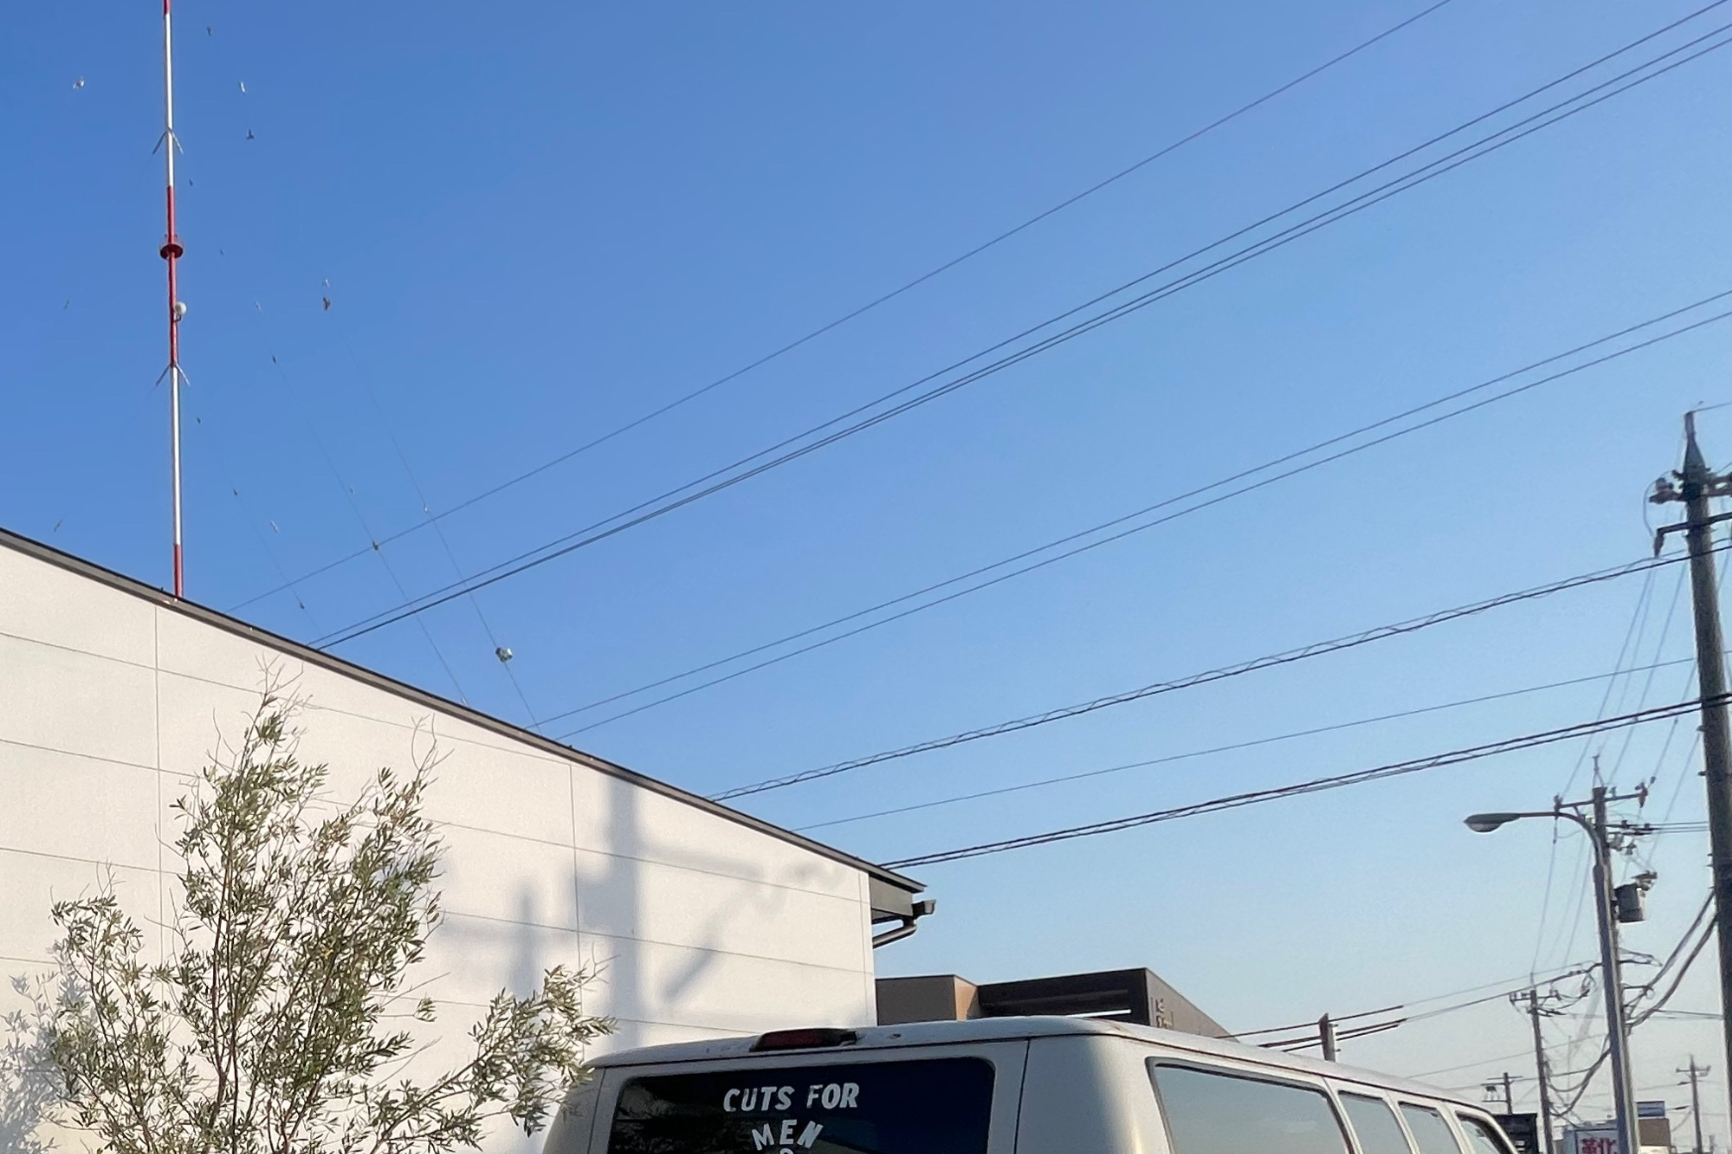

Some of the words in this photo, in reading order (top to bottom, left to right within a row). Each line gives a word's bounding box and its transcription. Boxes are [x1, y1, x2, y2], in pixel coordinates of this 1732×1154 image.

[723, 1085, 795, 1112] CUTS
[806, 1082, 860, 1110] FOR
[751, 1119, 824, 1151] MEN
